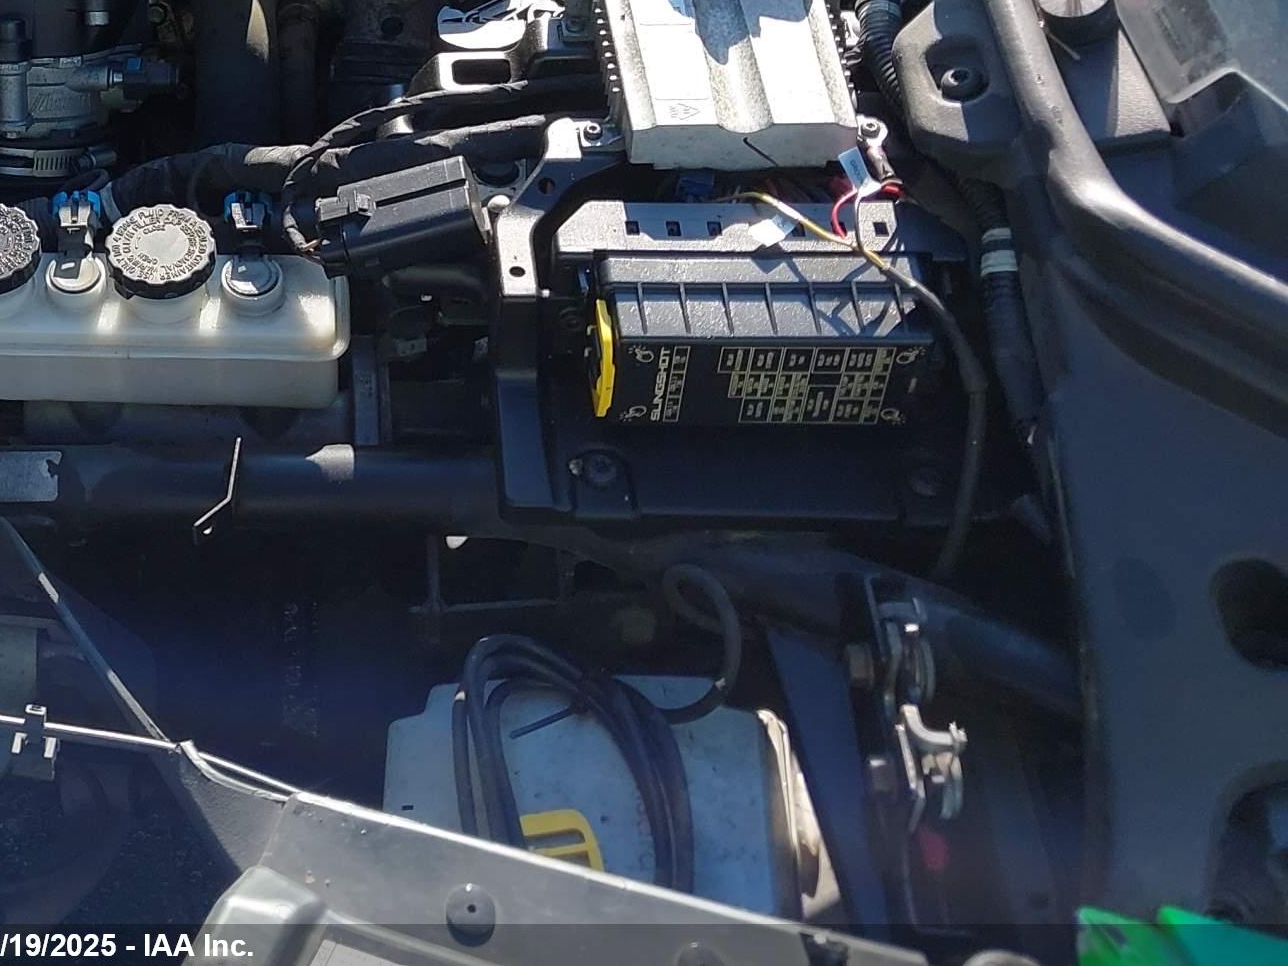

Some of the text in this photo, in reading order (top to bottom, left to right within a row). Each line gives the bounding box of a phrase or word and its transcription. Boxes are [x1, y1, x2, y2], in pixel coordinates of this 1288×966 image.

[116, 216, 137, 237] BRAKE
[138, 208, 164, 220] FLUID
[159, 255, 203, 281] CONTAINER
[132, 217, 161, 232] FILLER
[164, 217, 183, 226] CAP
[137, 253, 158, 265] OPEN
[650, 346, 671, 422] SLINGSHOT
